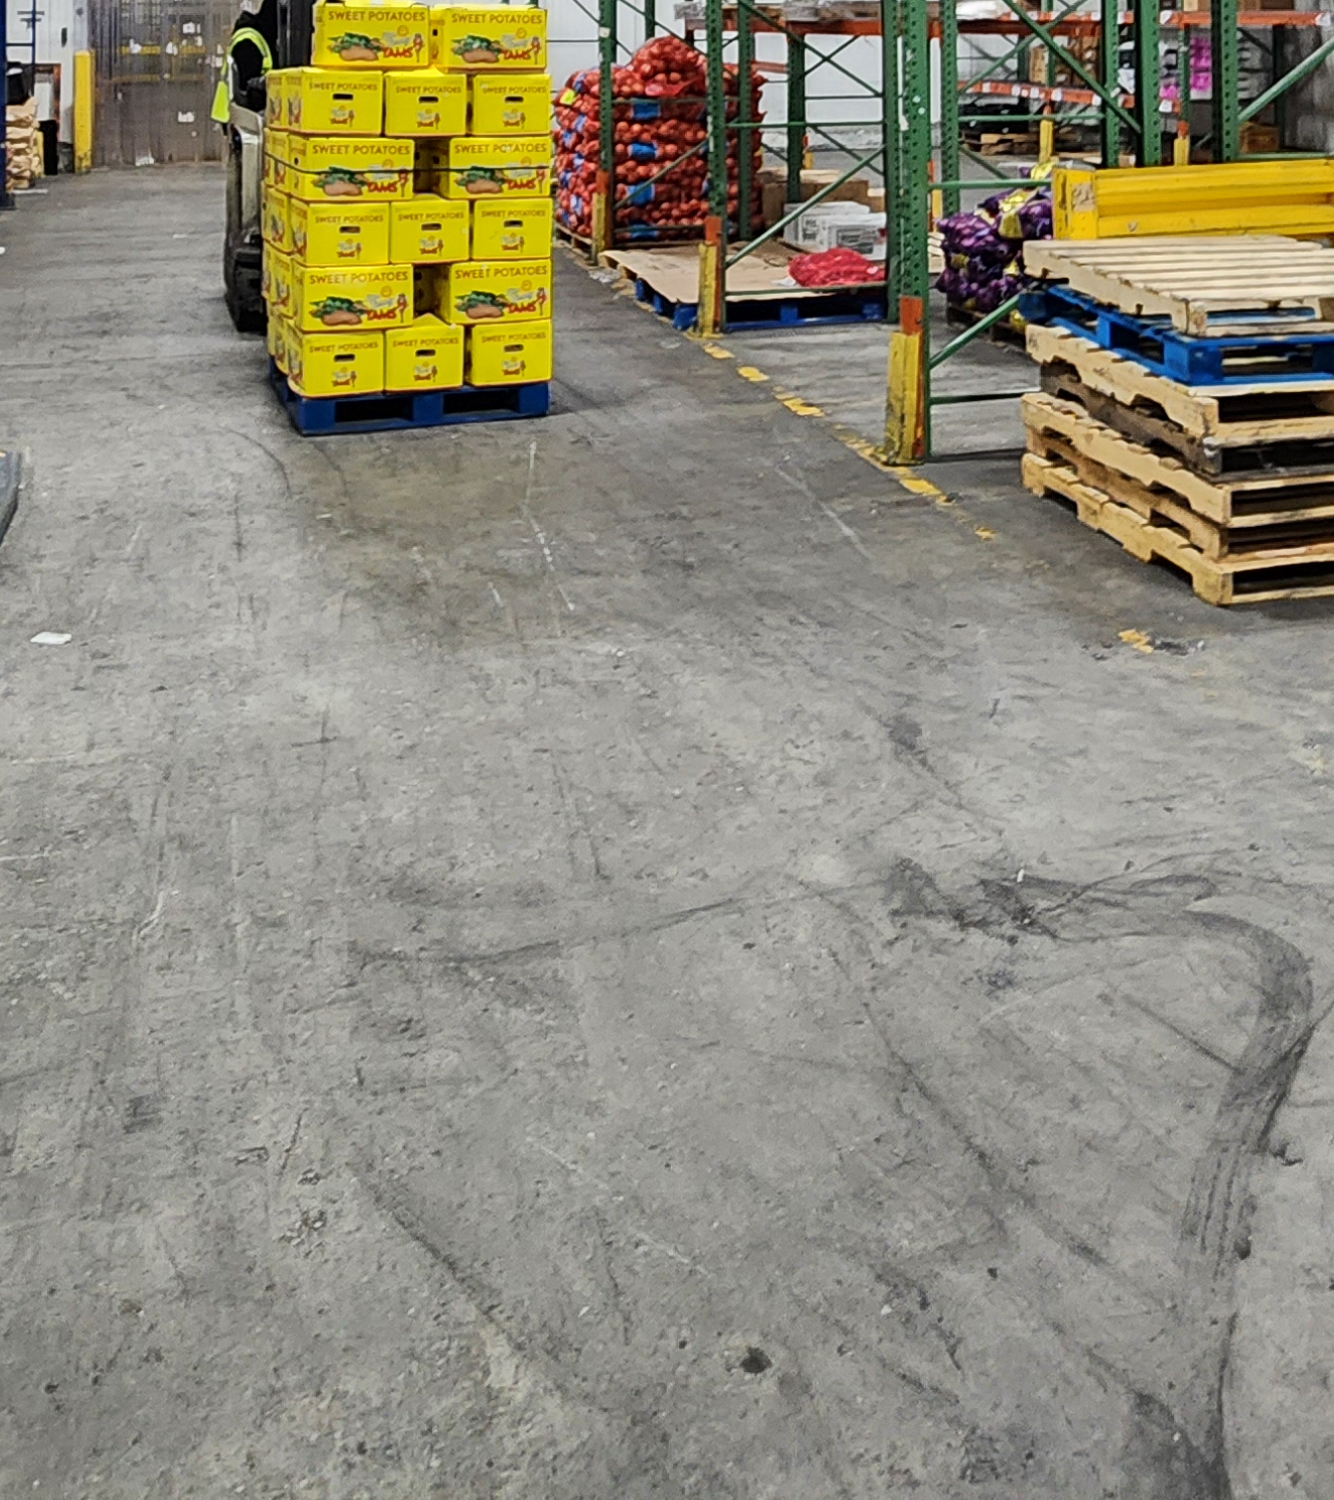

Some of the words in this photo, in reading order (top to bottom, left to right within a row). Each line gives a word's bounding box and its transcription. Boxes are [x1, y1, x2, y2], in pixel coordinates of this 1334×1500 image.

[328, 11, 365, 21] SWEET
[369, 11, 425, 22] POTATOES
[452, 13, 486, 23] SWEET
[489, 14, 542, 24] POTATOES
[312, 144, 350, 155] SWEET
[353, 144, 410, 155] POTATOES
[454, 143, 489, 154] SWEET
[493, 143, 547, 154] POTATOES
[310, 274, 347, 285] SWEET
[351, 271, 408, 283] POTATOES
[455, 269, 490, 279] SWEET
[493, 266, 547, 277] POTATOES
